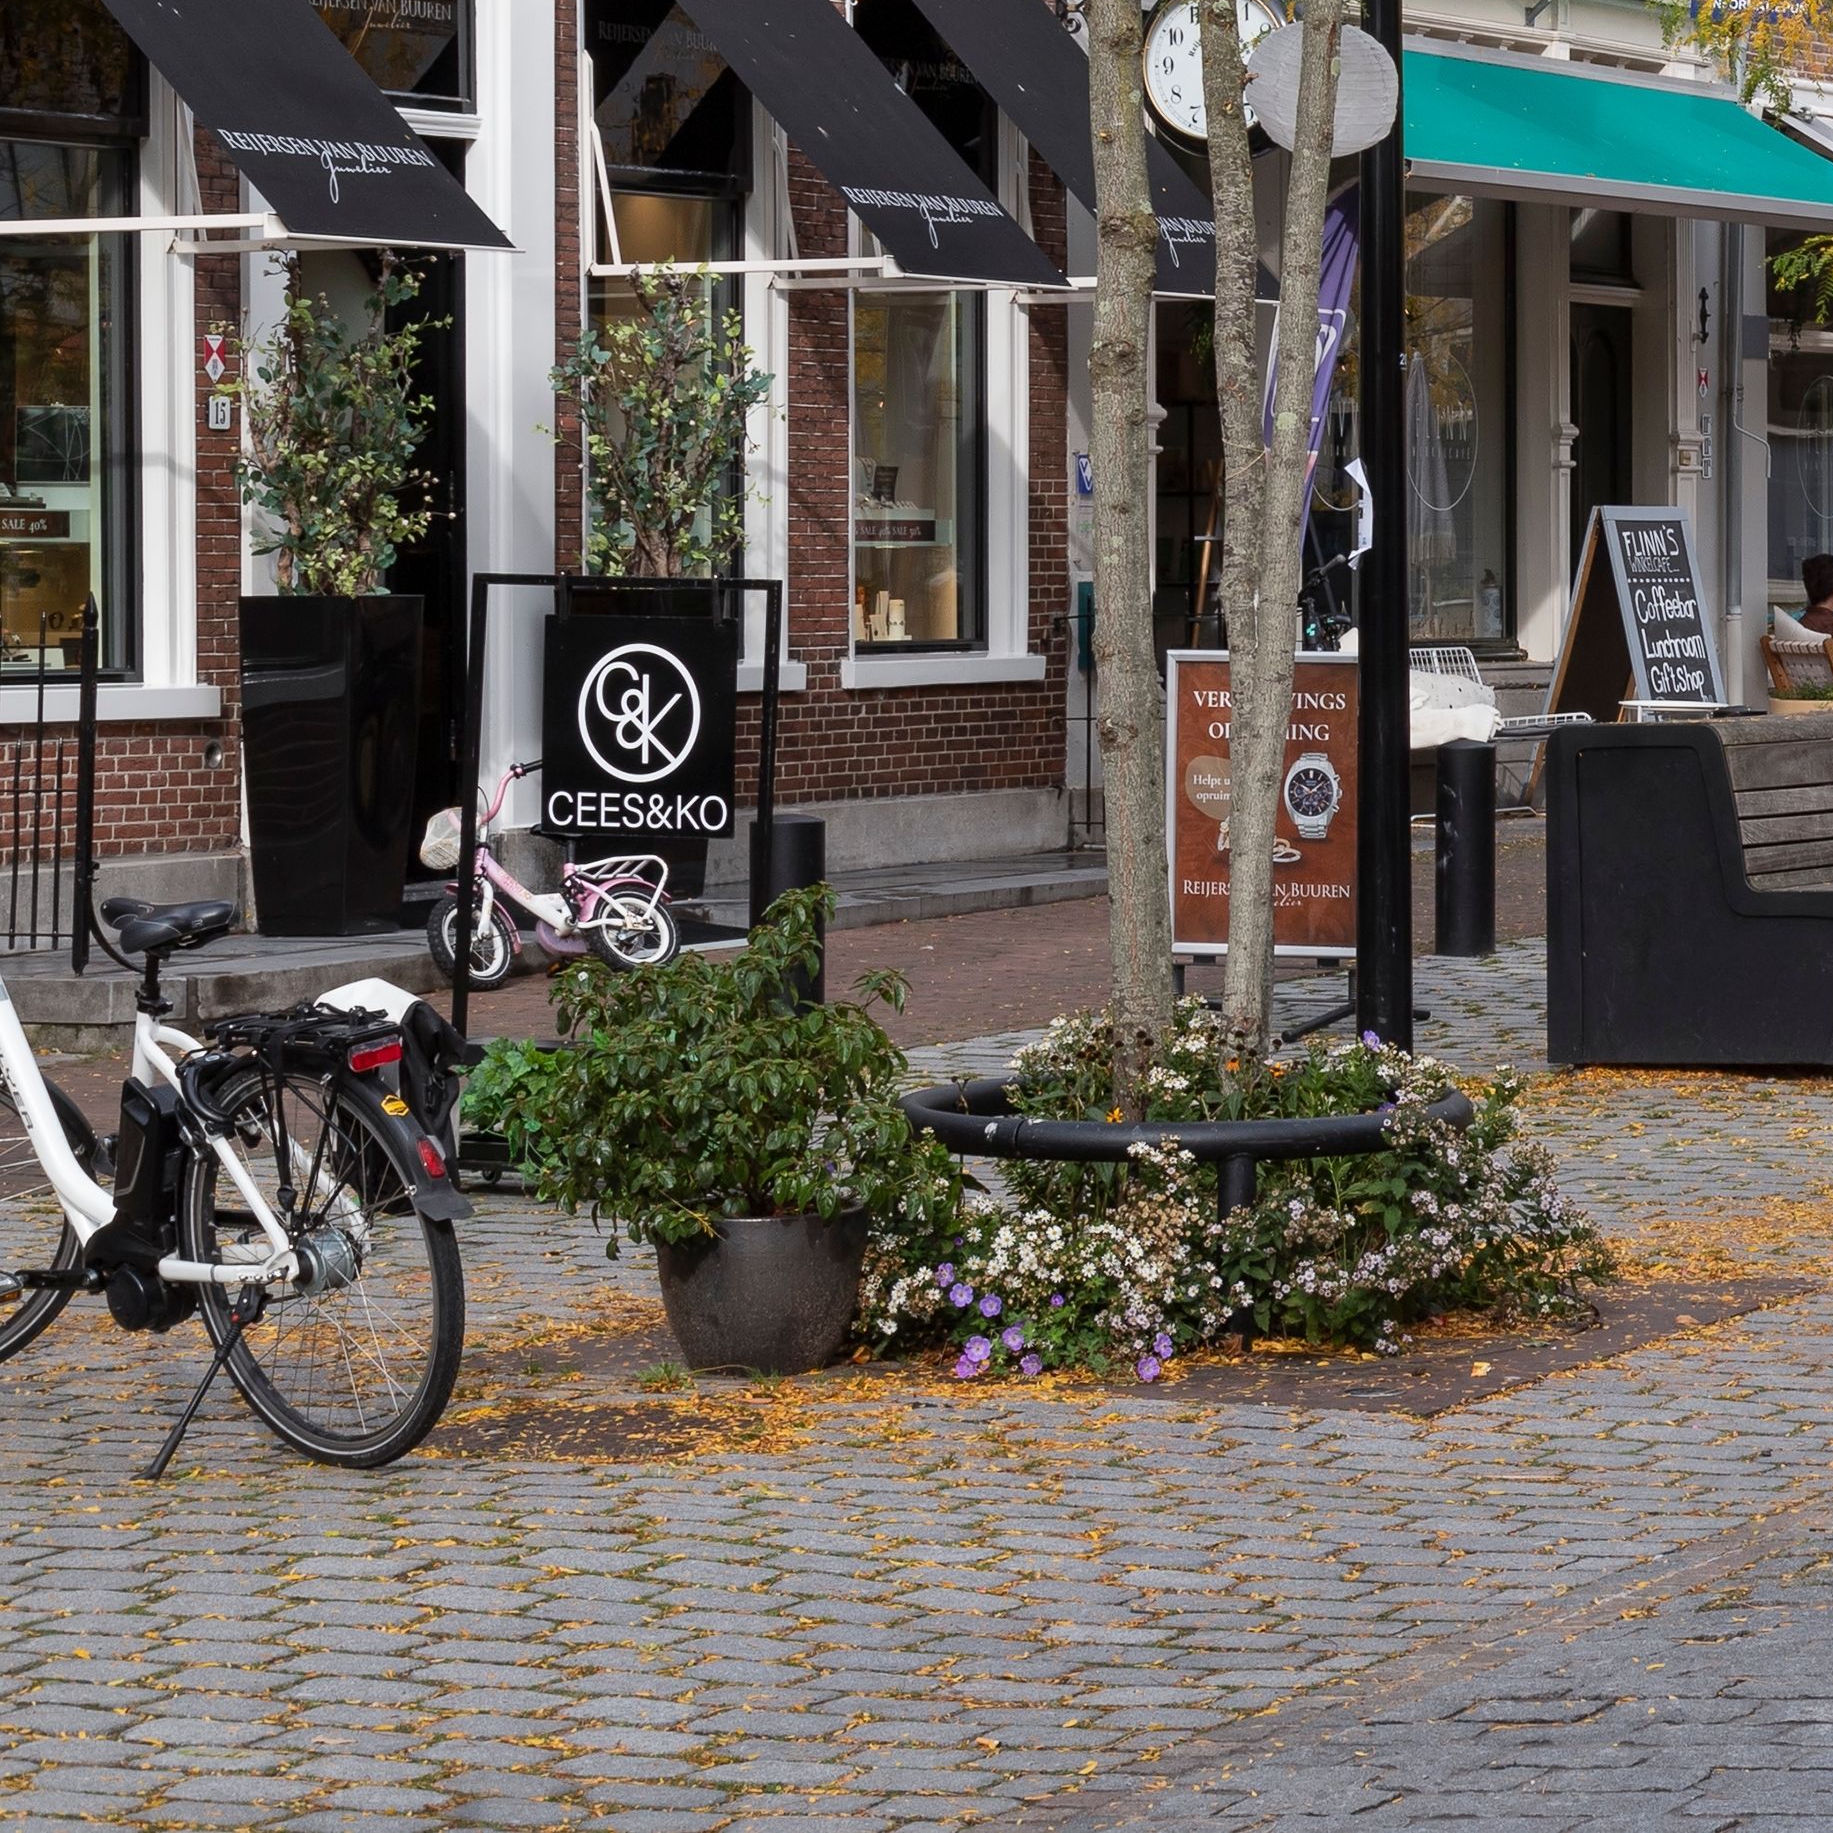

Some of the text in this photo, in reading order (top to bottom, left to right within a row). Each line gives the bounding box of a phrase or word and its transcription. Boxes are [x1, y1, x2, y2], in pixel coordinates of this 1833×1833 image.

[1169, 27, 1184, 46] 10
[1163, 56, 1174, 75] 9
[1171, 85, 1182, 104] 8
[1190, 105, 1201, 123] 7
[217, 128, 435, 167] REIJERSEN VAN BUUREN
[841, 185, 1004, 217] REIJERSEN VAN BUUREN
[215, 401, 226, 425] 15
[1, 518, 48, 534] SALE 40%
[1635, 585, 1697, 624] Coffeebar
[1641, 628, 1706, 659] Lunchroom
[1193, 774, 1222, 789] Helpt
[548, 790, 728, 832] CEES&KO
[1291, 882, 1351, 899] BUUREN
